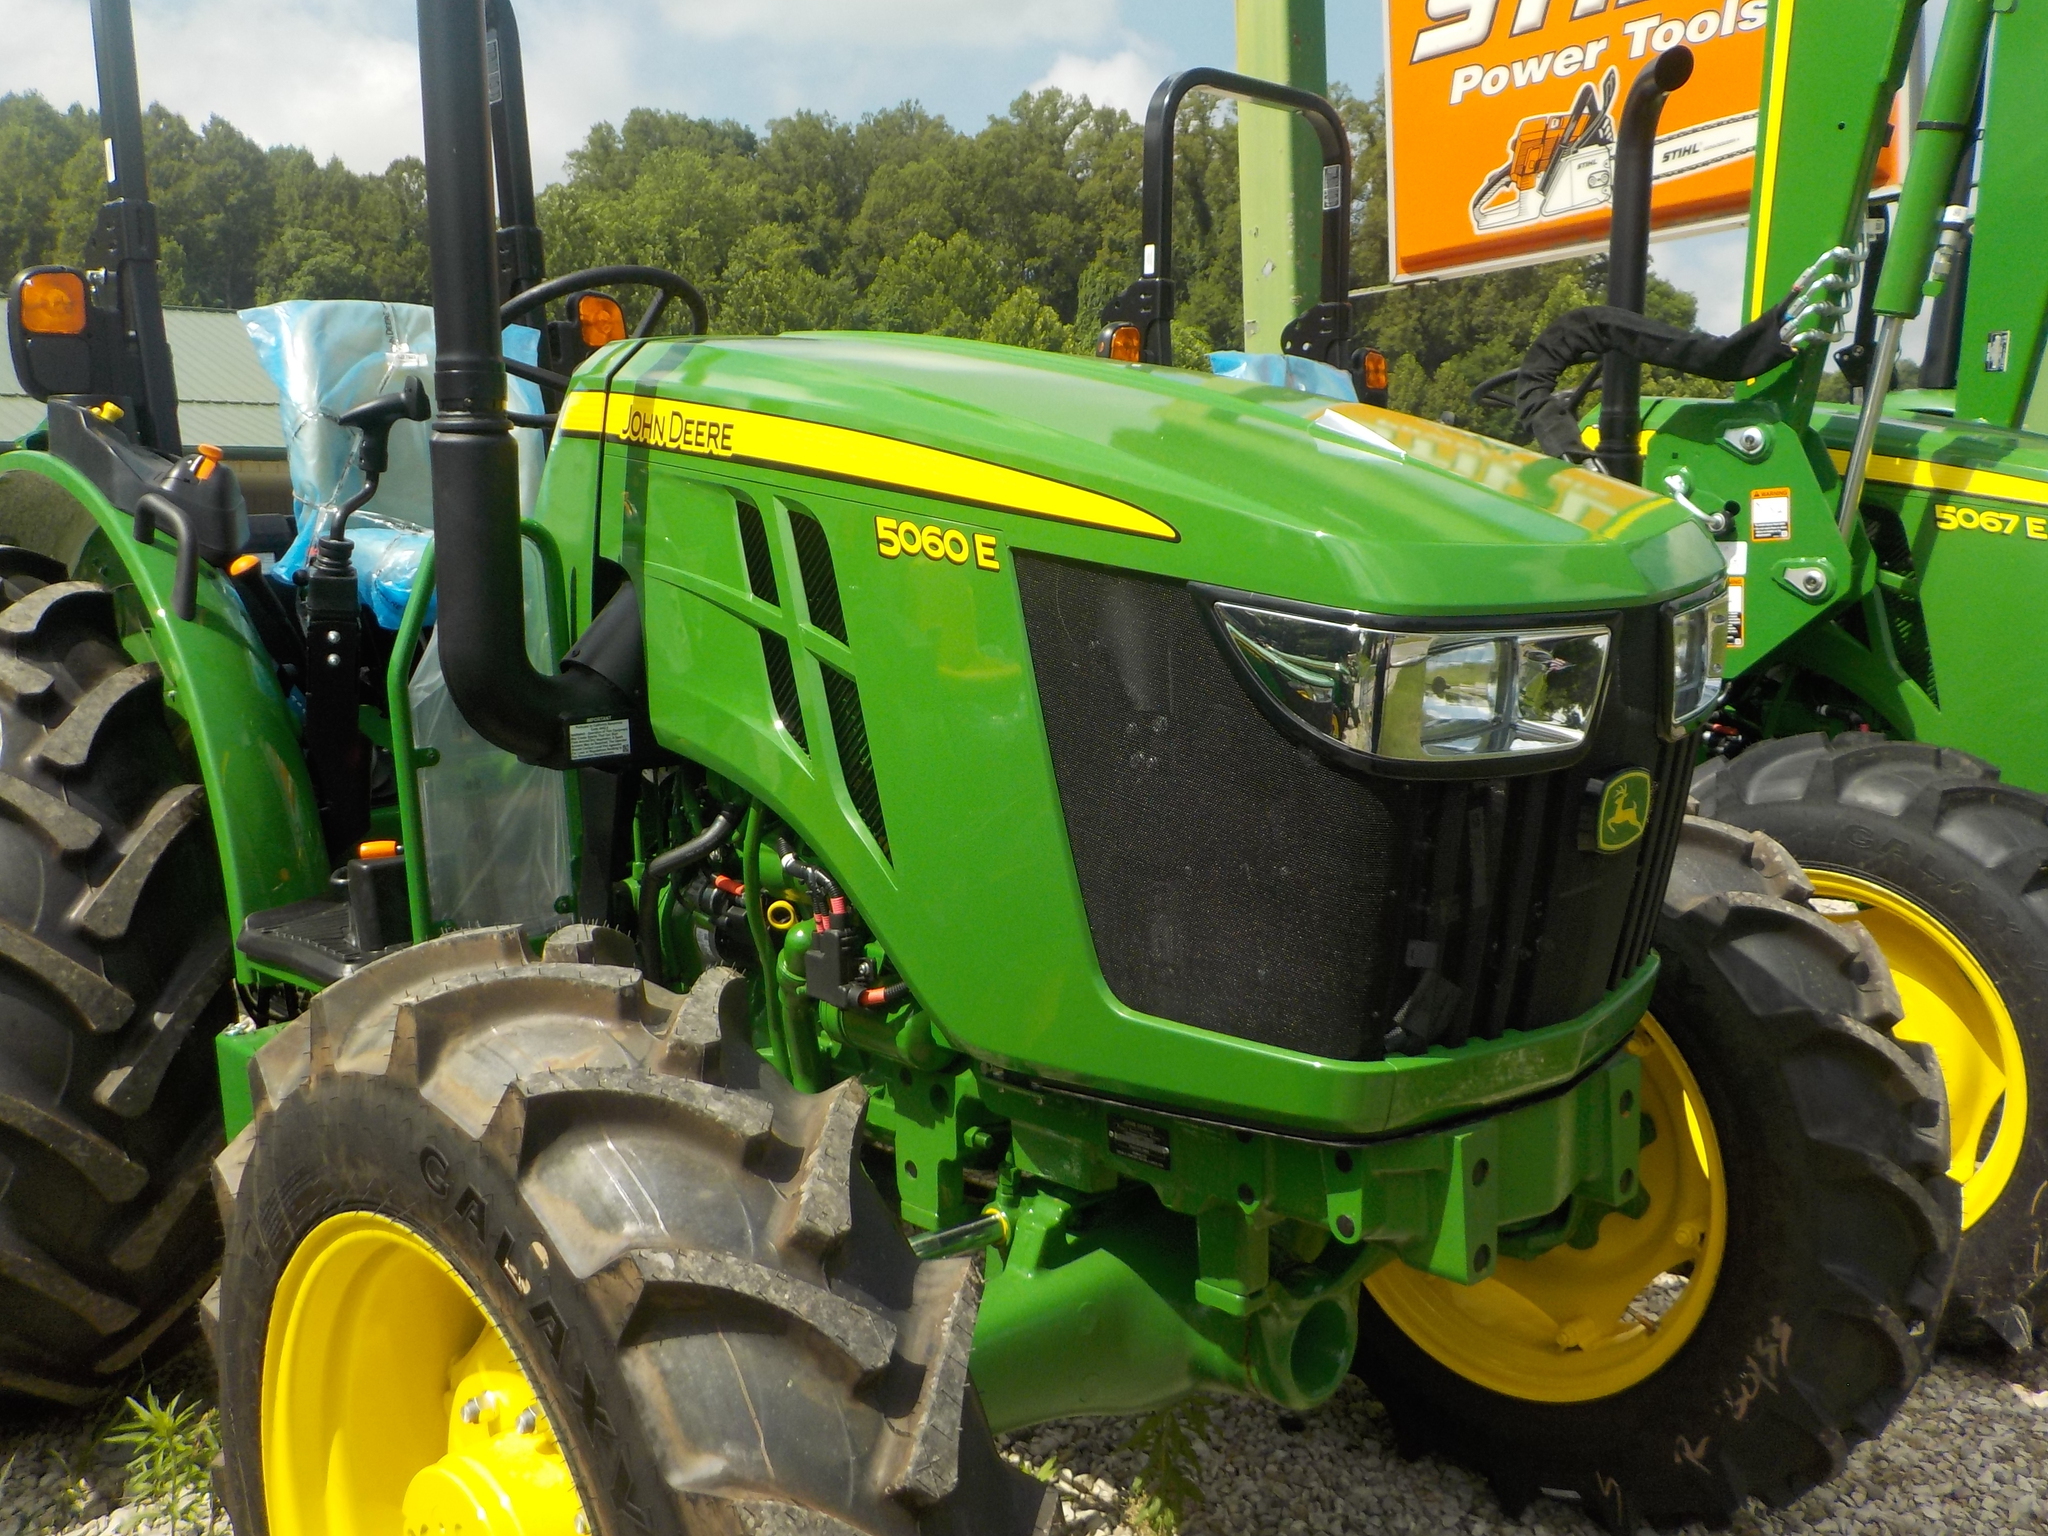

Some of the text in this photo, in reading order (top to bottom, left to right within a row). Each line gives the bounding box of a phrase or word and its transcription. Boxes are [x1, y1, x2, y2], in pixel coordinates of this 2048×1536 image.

[1449, 36, 1609, 106] Power
[1623, 0, 1767, 59] Tools
[1577, 159, 1598, 170] STIHL
[1661, 143, 1700, 163] STIHL
[622, 404, 735, 451] JOHN DEERE
[1934, 504, 2048, 540] 5067 E
[874, 515, 1000, 573] 5060 E
